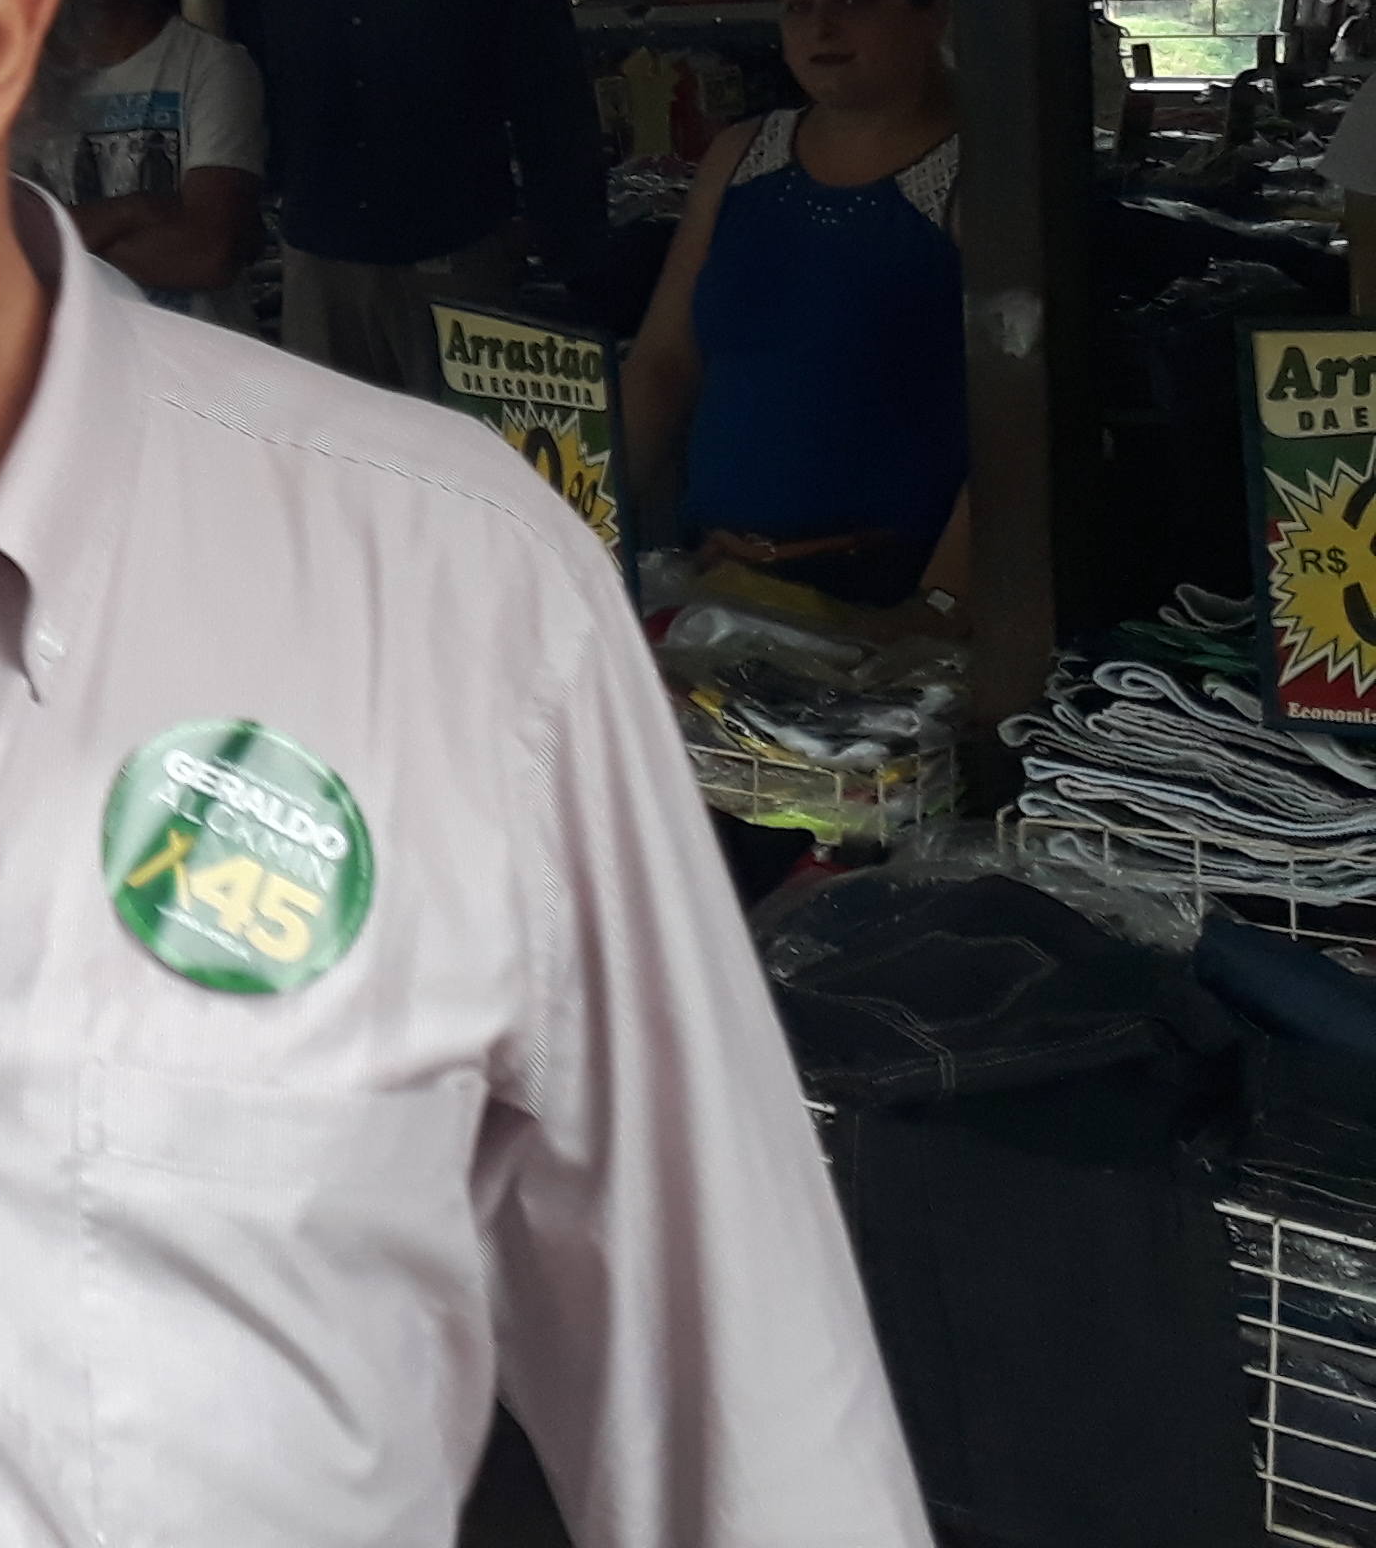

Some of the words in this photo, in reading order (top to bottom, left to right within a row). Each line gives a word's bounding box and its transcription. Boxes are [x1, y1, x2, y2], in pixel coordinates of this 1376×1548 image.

[1298, 408, 1341, 431] DA
[1299, 545, 1349, 579] R$
[162, 749, 348, 861] GERALDO
[188, 854, 324, 963] 45
